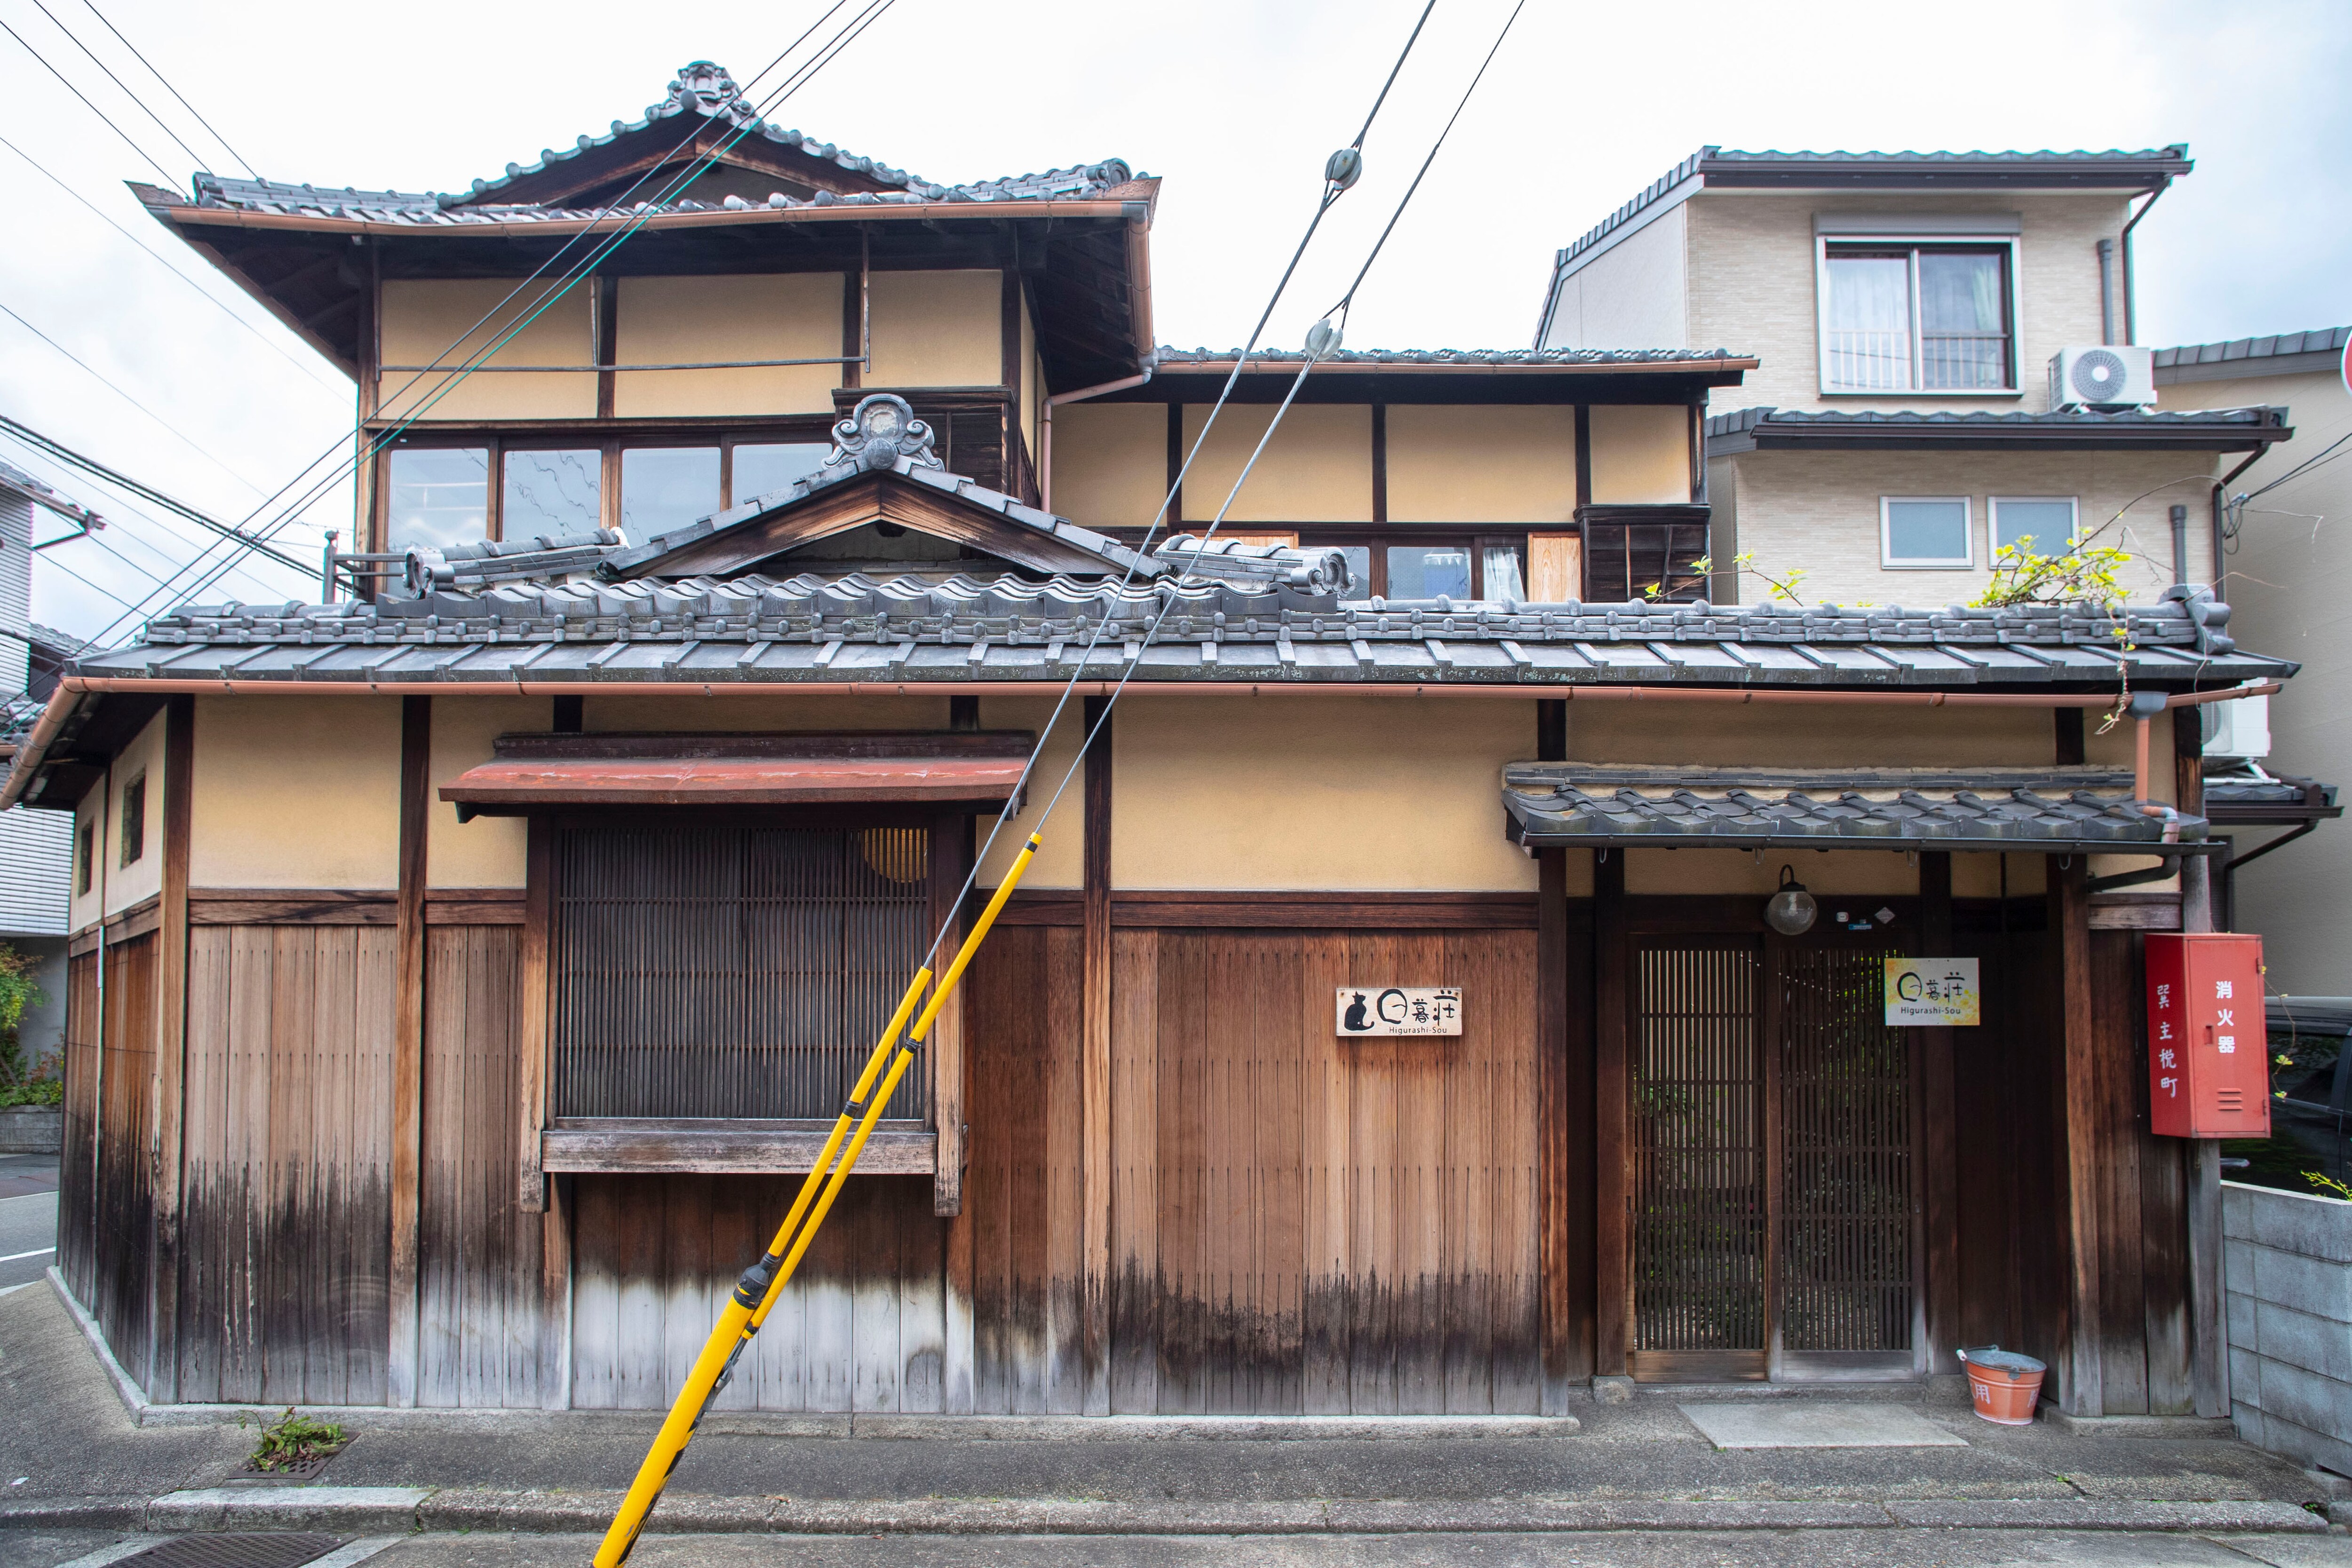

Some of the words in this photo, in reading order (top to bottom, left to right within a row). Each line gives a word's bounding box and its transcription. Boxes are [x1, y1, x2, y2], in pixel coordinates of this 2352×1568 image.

[1897, 971, 1965, 1003] 日暮荘
[1377, 988, 1458, 1026] 日暮荘
[1901, 1007, 1961, 1015] Higurashi-Sou
[2216, 980, 2236, 1053] 消火器
[1389, 1027, 1447, 1035] Higurashi-Sou
